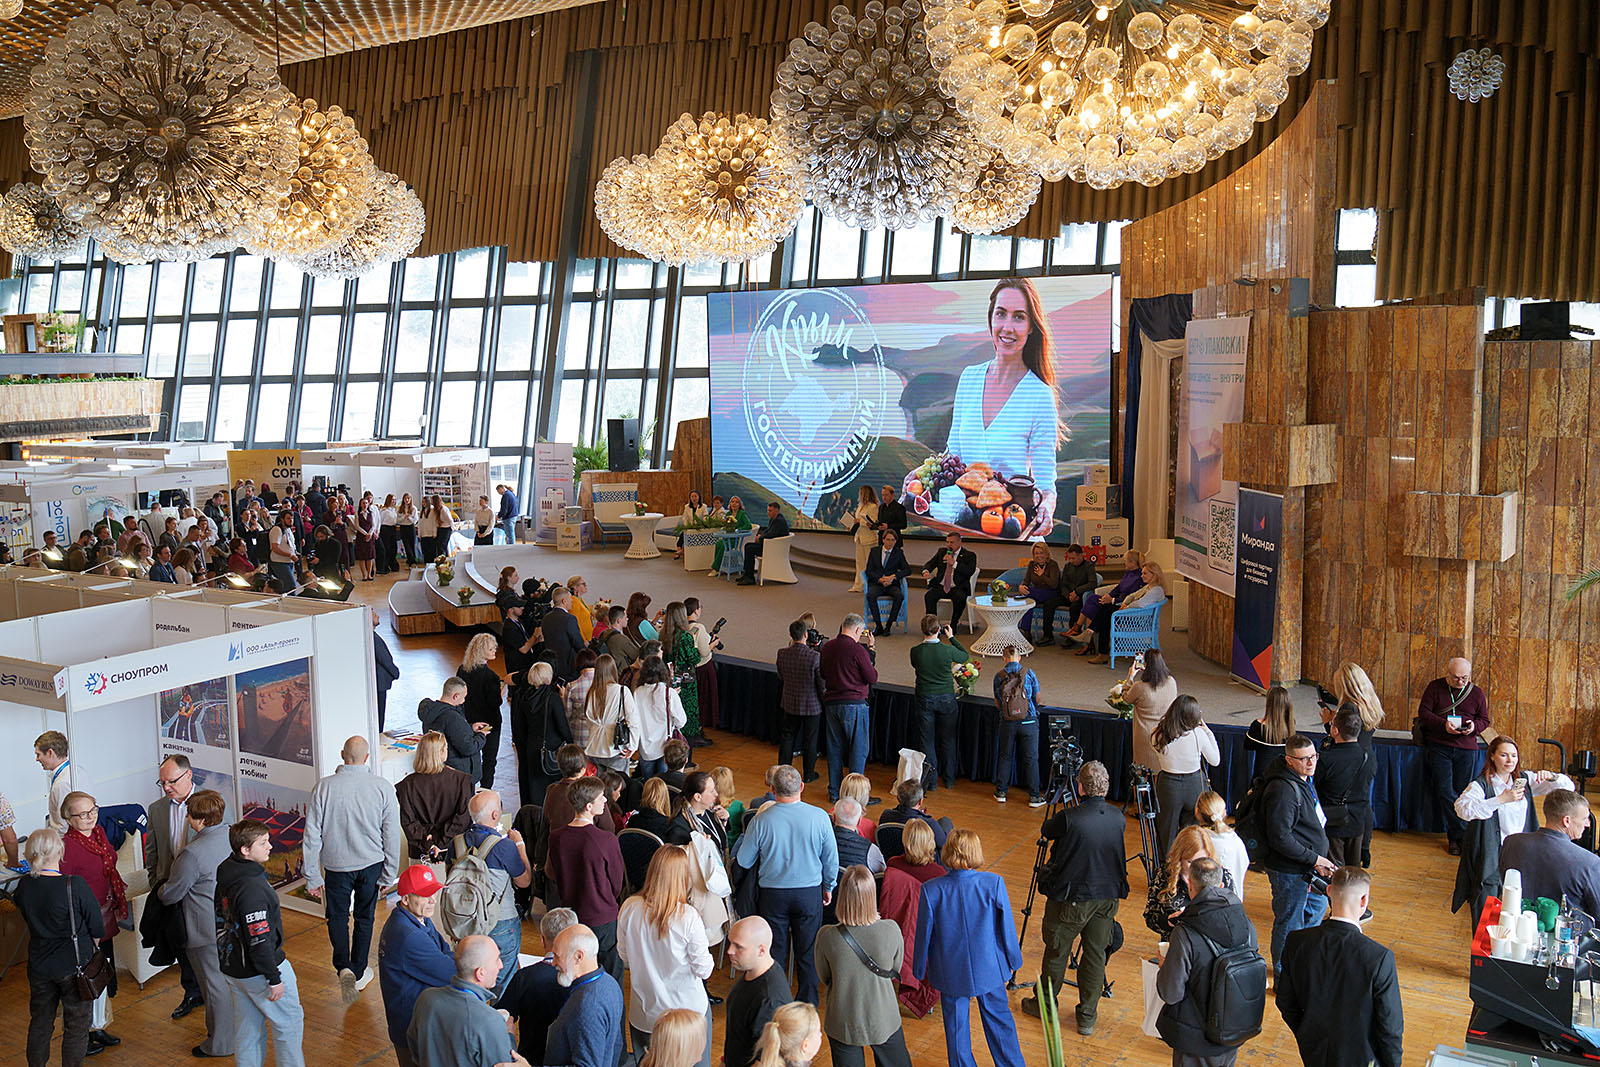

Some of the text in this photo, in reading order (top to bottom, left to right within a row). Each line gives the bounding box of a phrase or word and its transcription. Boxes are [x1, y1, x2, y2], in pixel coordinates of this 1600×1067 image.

[765, 300, 854, 381] Крым
[754, 399, 876, 479] ГОСТЕПРИИМНЫЙ
[277, 456, 294, 466] MY
[1241, 533, 1275, 552] Миранда
[155, 623, 190, 633] родельбан
[246, 644, 259, 653] ООО
[110, 663, 168, 684] СНОУПРОМ
[162, 742, 194, 754] канатная
[239, 757, 267, 769] летний
[240, 768, 268, 780] тюбинг
